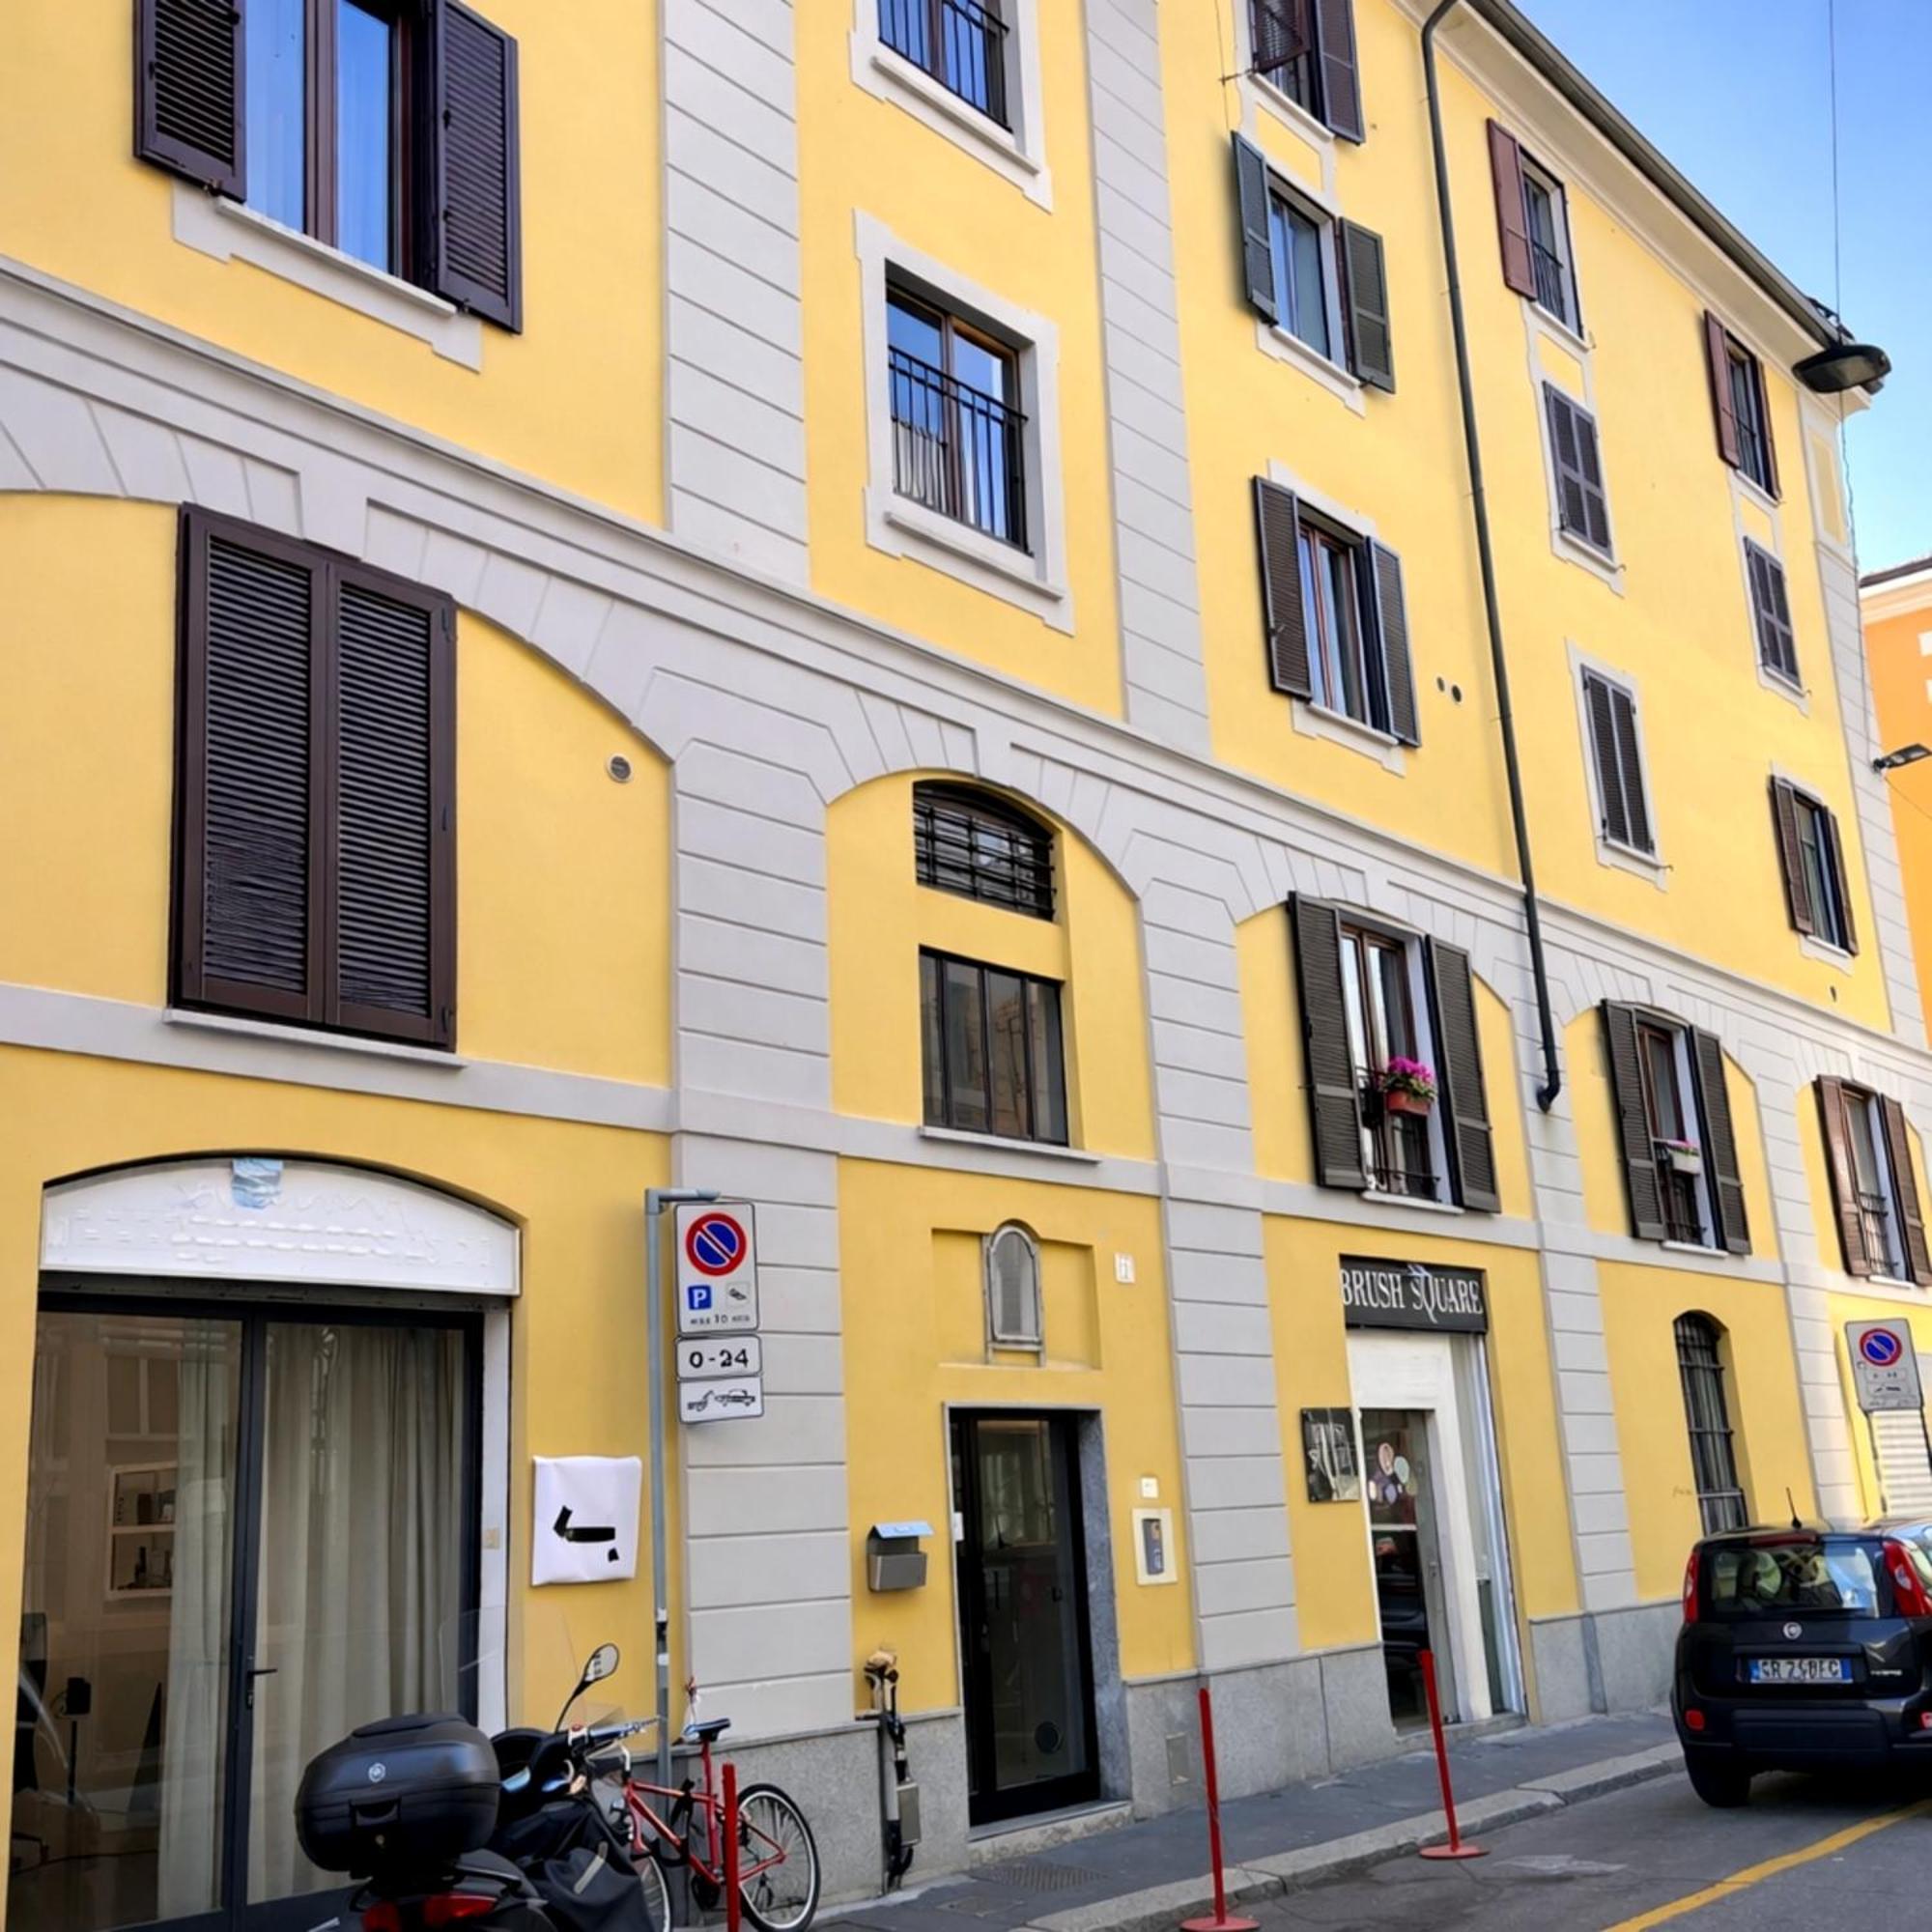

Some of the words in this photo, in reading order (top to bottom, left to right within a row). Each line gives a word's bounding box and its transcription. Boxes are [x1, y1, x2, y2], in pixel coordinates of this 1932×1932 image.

[693, 1289, 708, 1310] P
[1340, 1268, 1406, 1309] BRUSH
[1410, 1266, 1484, 1323] SQUARE
